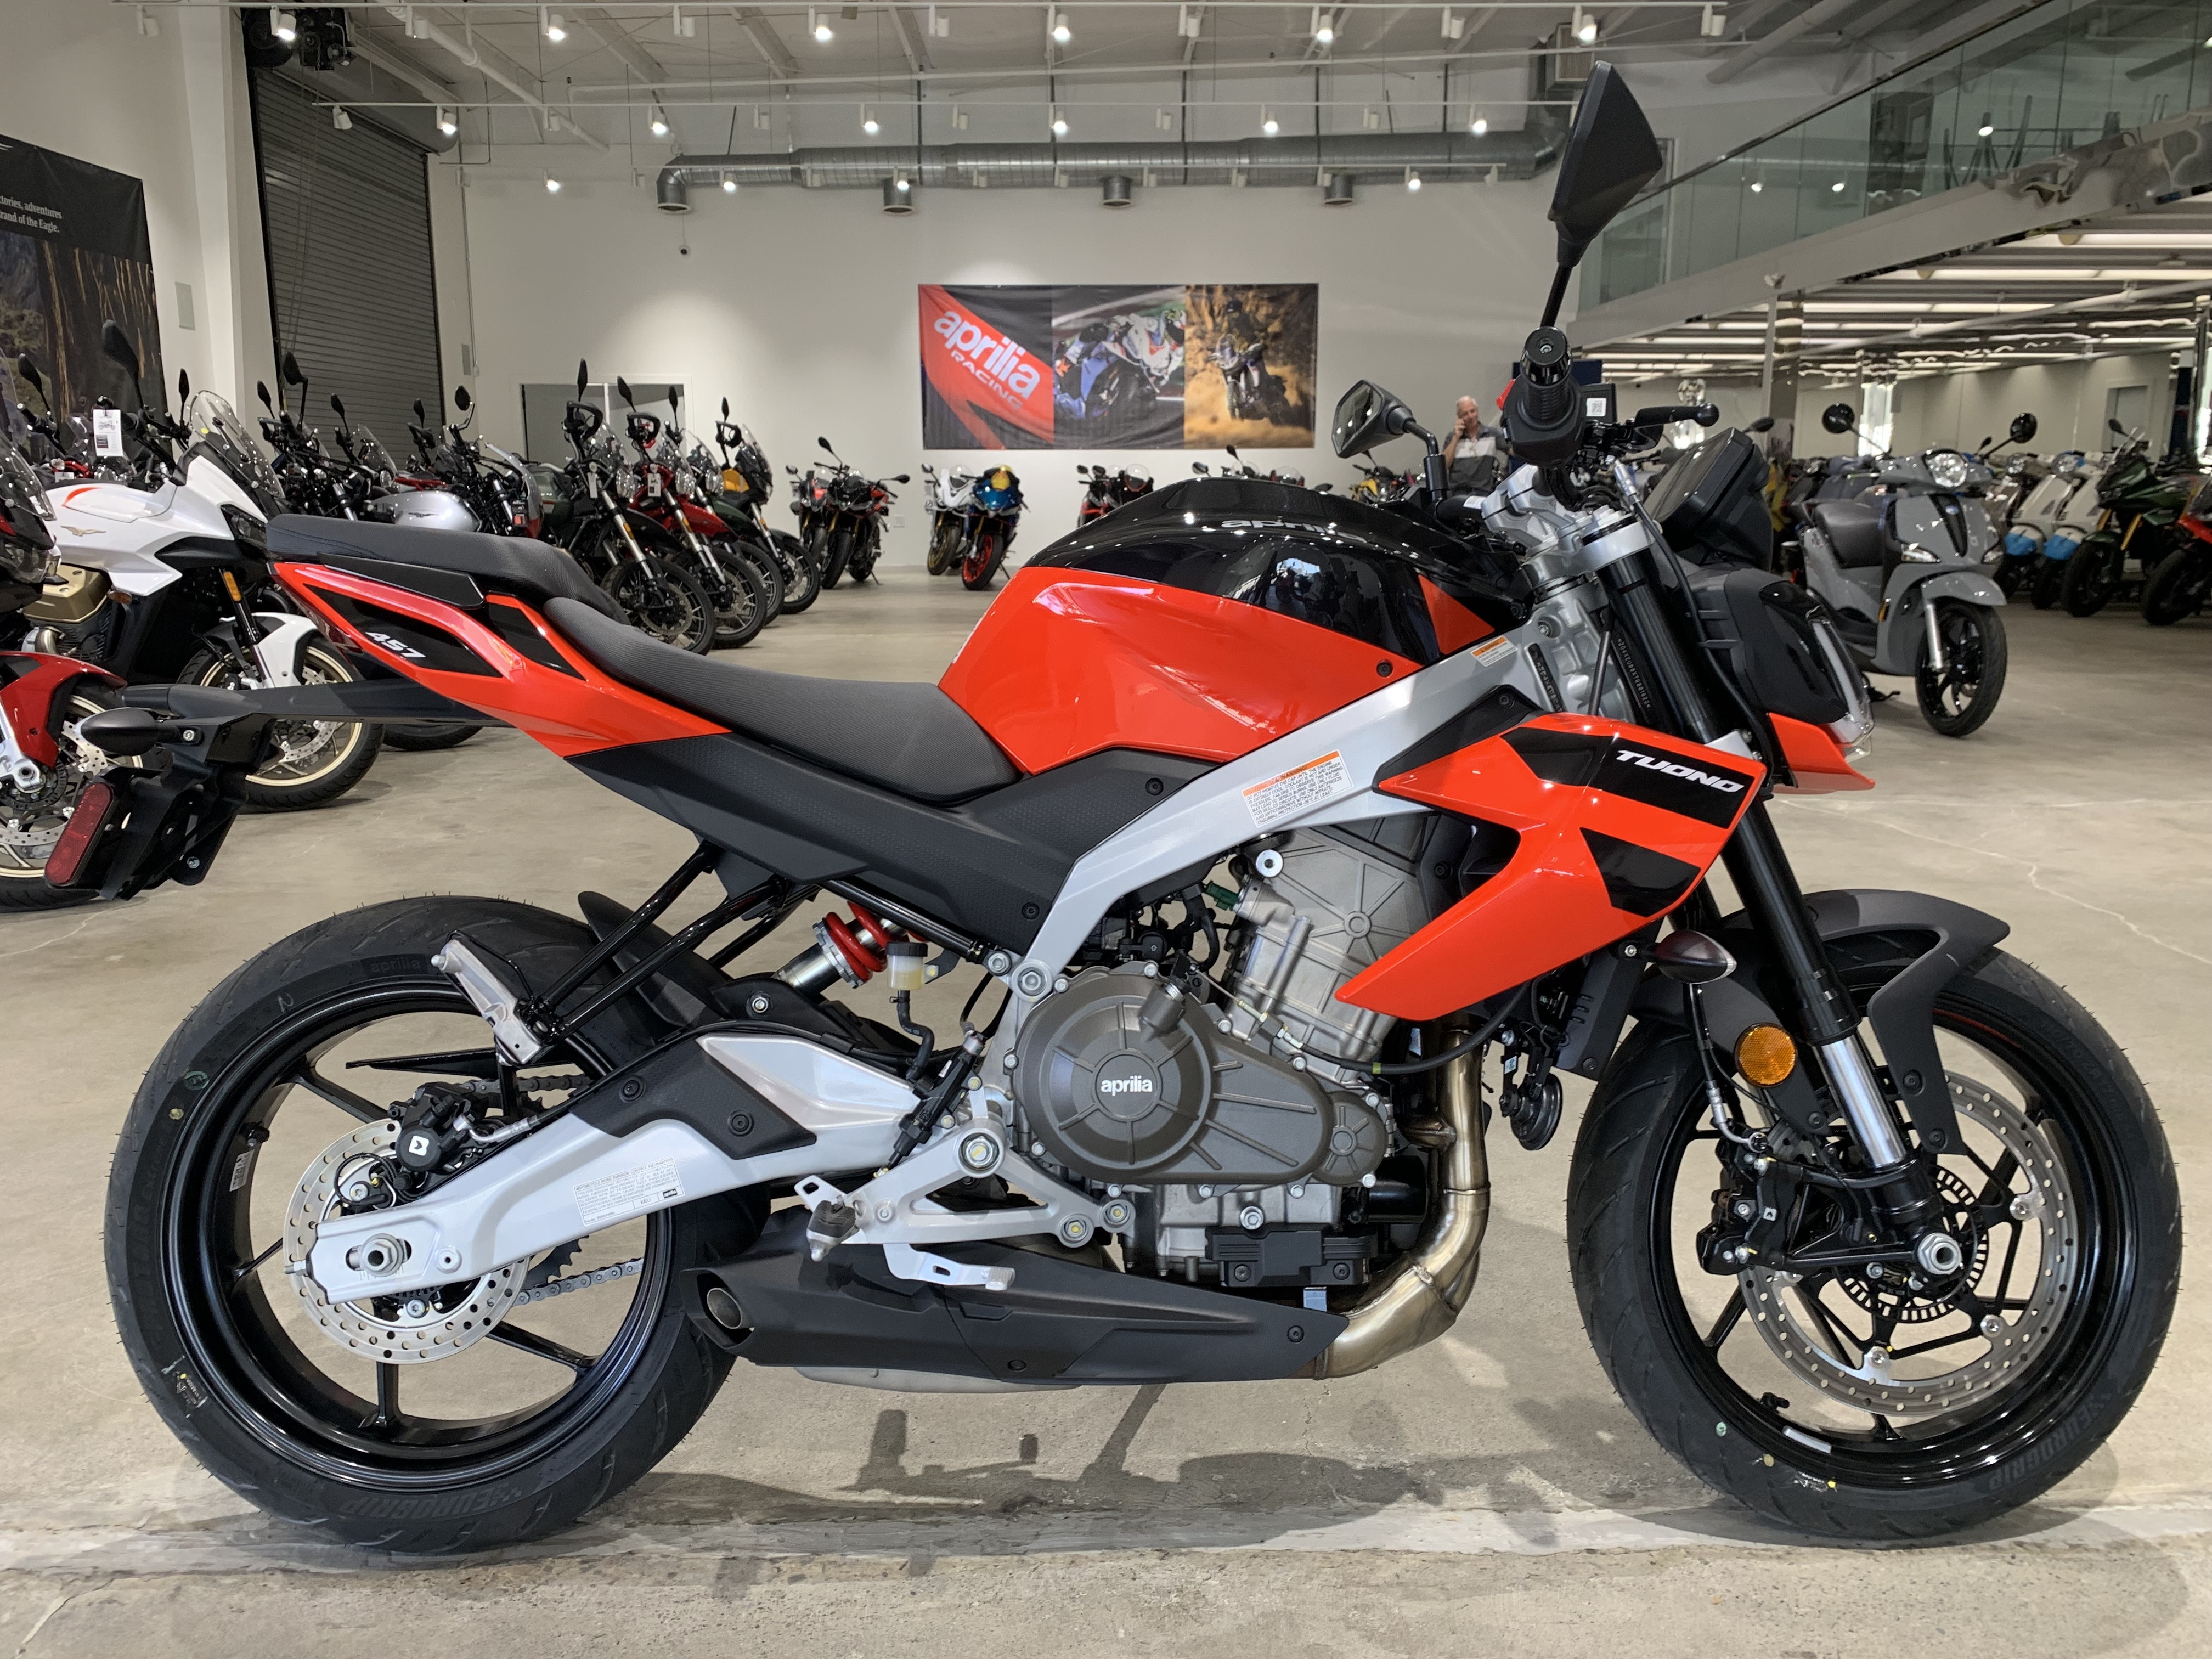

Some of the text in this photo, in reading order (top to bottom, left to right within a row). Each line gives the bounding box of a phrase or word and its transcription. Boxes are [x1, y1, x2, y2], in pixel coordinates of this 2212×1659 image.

[0, 195, 63, 219] tories, adventures
[0, 211, 60, 233] rand of the Eagle.
[934, 311, 1040, 399] aprilia
[951, 350, 1023, 410] RACING
[365, 632, 426, 657] 457
[1285, 777, 1303, 789] COOLANT
[1617, 749, 1745, 793] TUONO
[1101, 1075, 1152, 1096] aprilia
[1989, 1405, 2092, 1489] EUROGRIP
[340, 1489, 493, 1520] EUROGRIP
